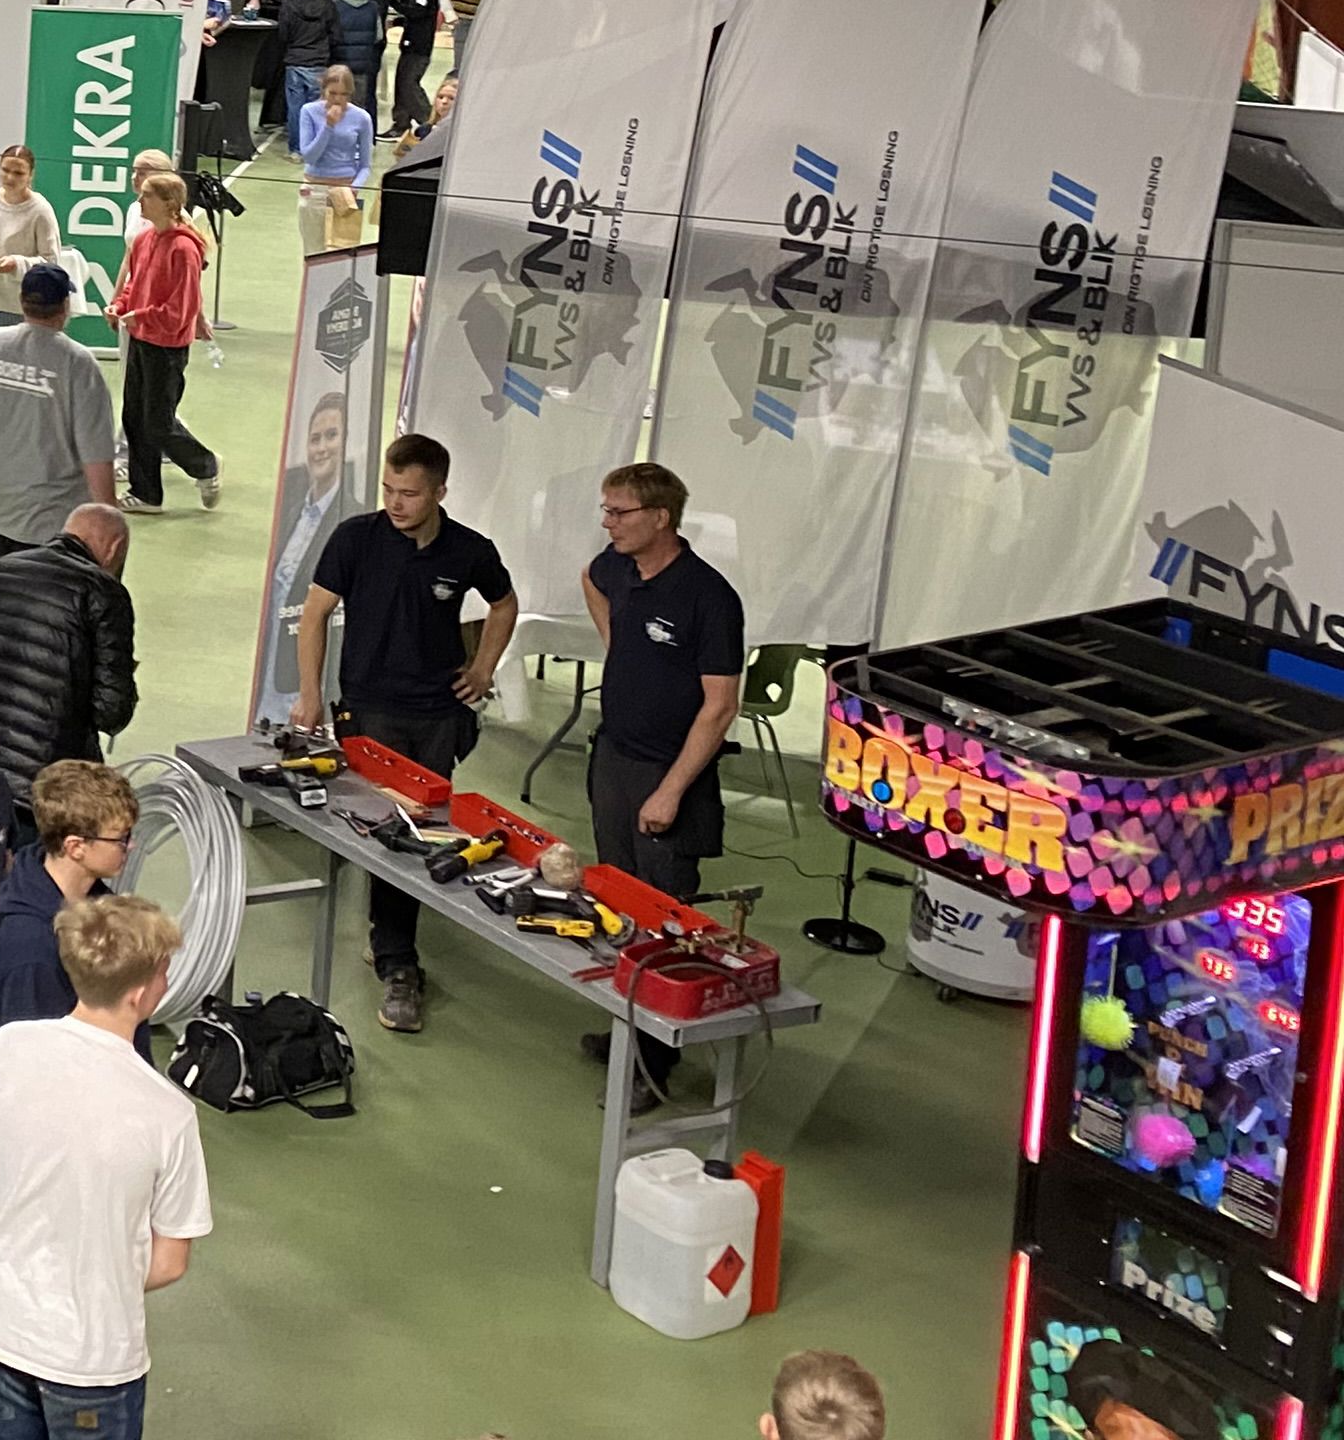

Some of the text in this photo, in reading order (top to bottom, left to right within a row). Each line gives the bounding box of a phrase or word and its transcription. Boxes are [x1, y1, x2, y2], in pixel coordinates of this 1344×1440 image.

[68, 34, 136, 236] DEKRA
[602, 258, 617, 286] DIN
[619, 117, 640, 188] LØSNING
[860, 130, 899, 304] DIN RIGTIGE LØSNING
[507, 175, 576, 371] FYNS
[551, 185, 601, 372] VVS & BLIK
[758, 191, 831, 393] FYNS
[819, 287, 844, 314] &
[825, 201, 858, 280] BLIK
[1010, 220, 1089, 427] FYNS
[1062, 229, 1118, 428] VVS & BLIK
[1122, 155, 1164, 336] DIN RIGTIGE LØSNING
[825, 713, 1068, 874] BOXER
[1121, 1259, 1218, 1337] Prize
